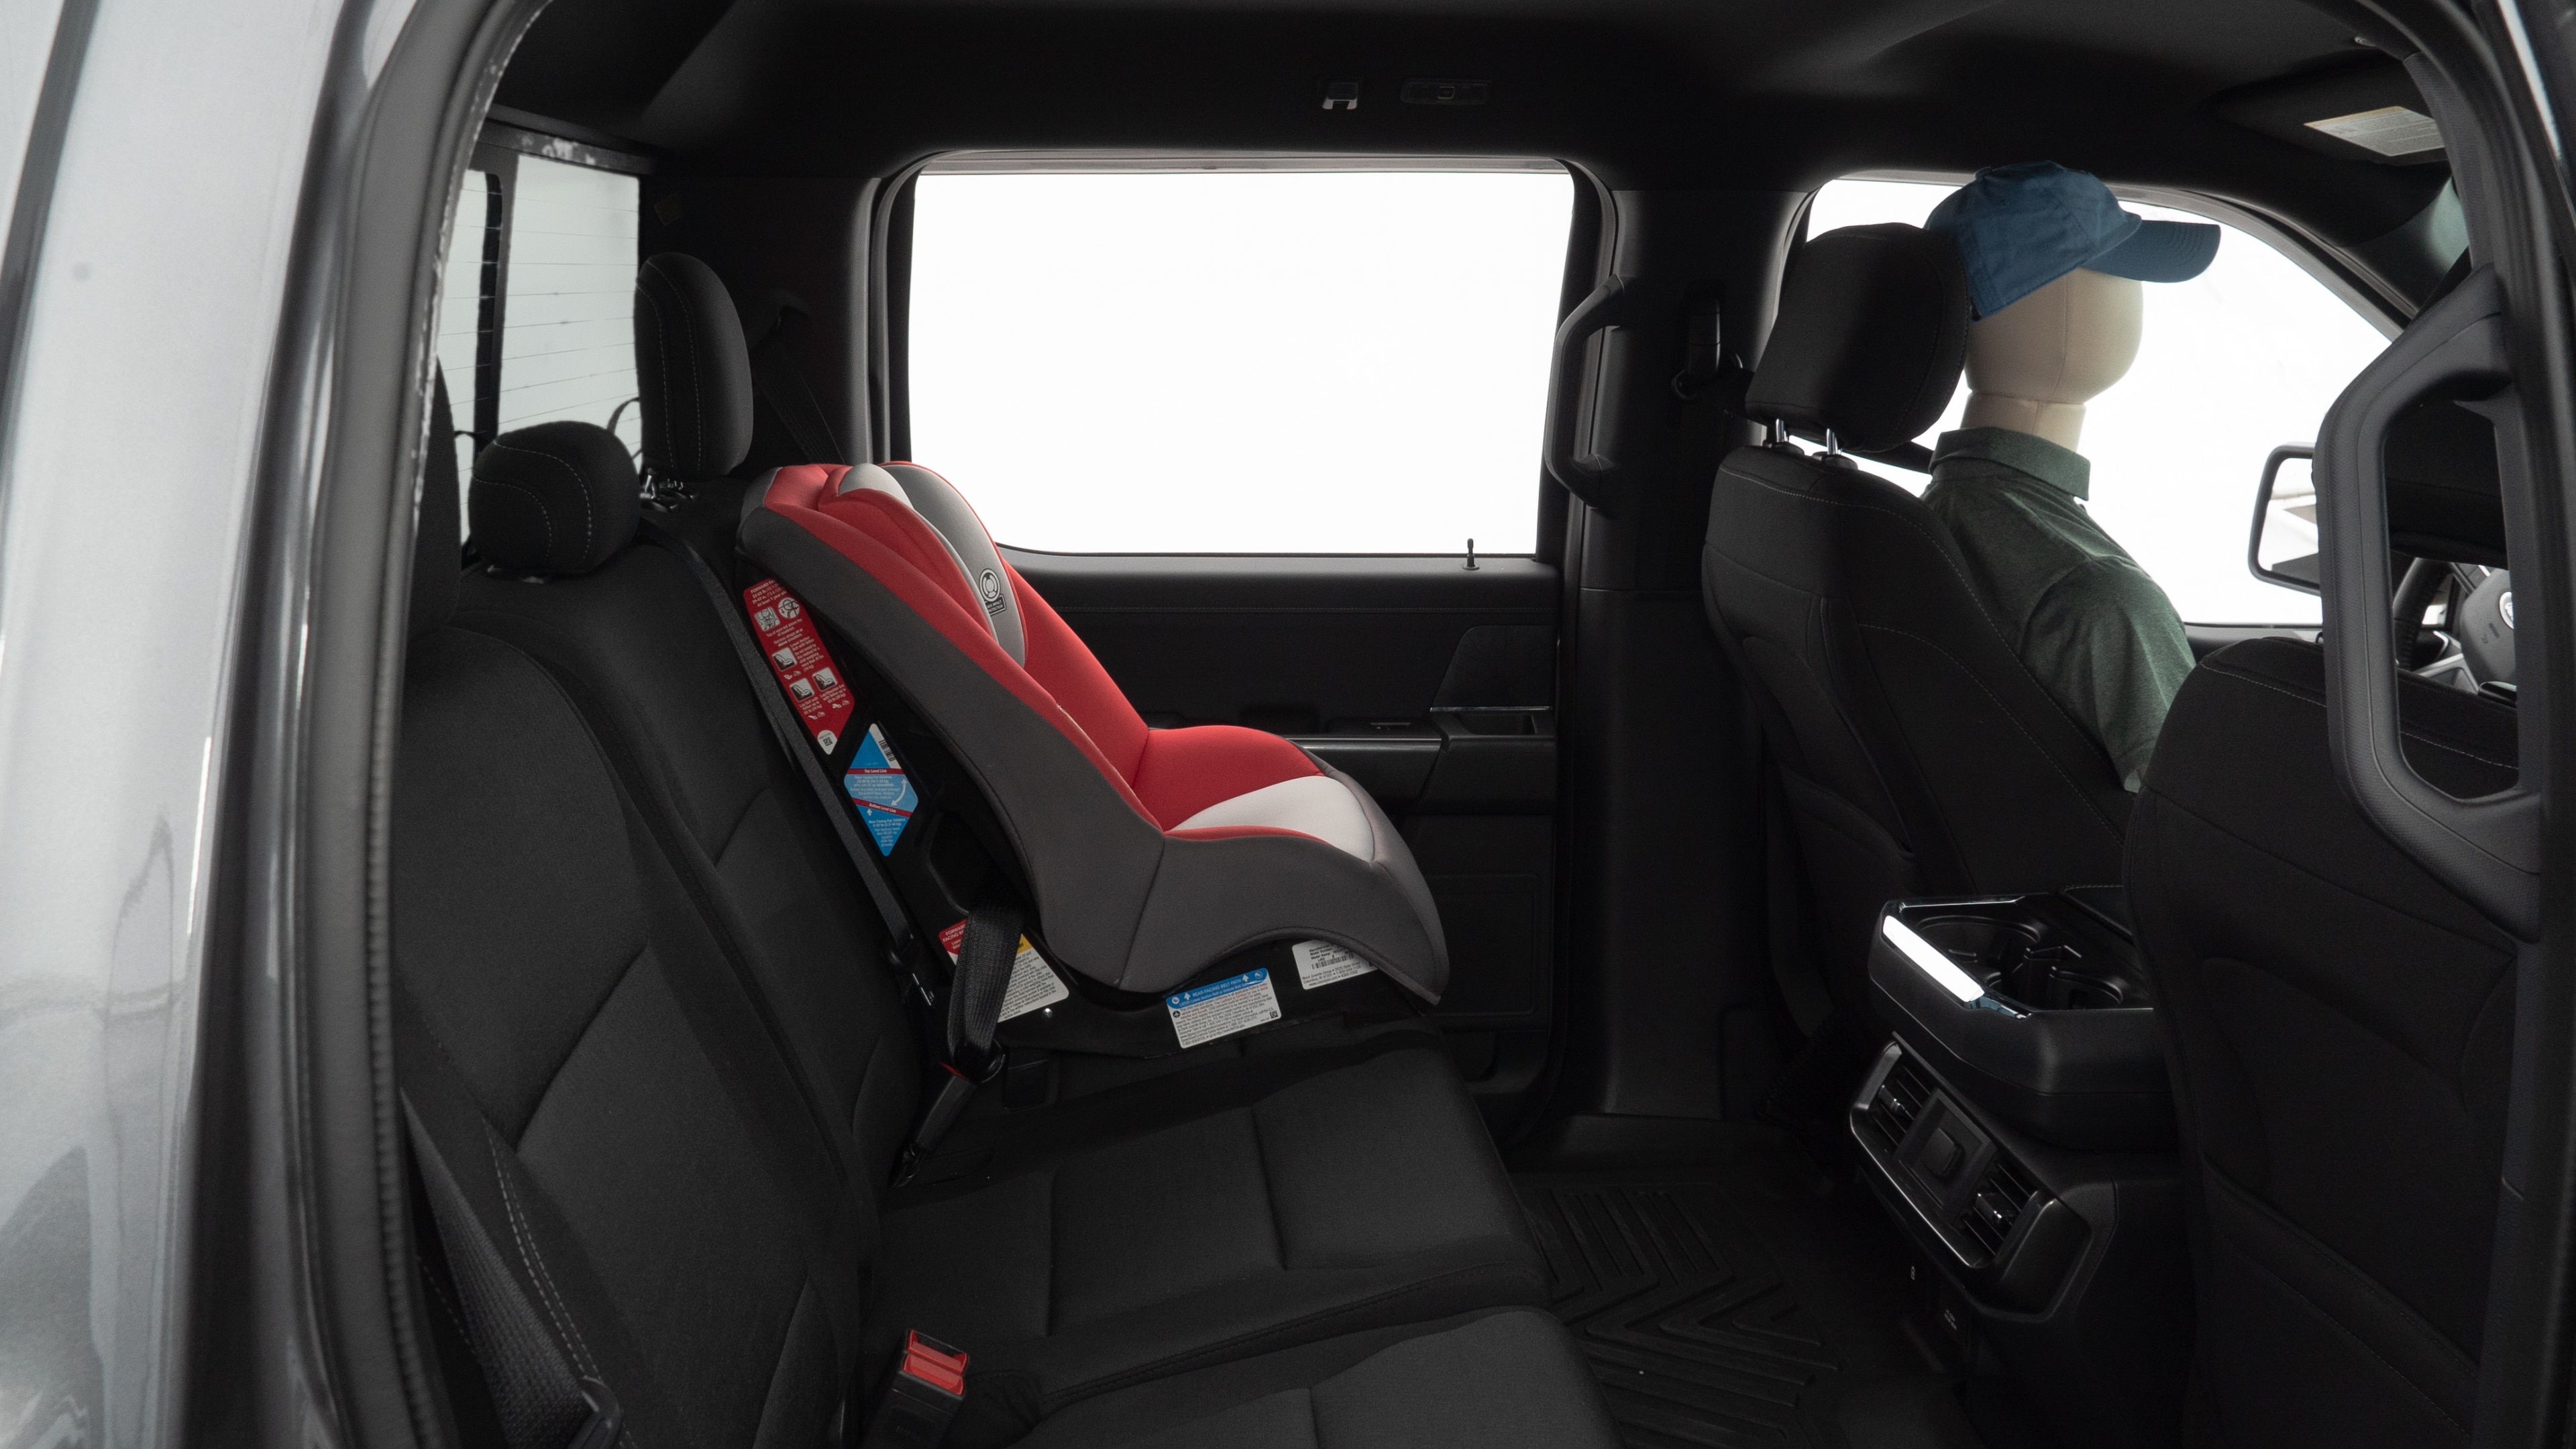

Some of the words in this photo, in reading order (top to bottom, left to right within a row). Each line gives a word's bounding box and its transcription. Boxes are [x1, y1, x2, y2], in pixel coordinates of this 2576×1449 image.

[750, 582, 769, 594] FORWARD
[943, 932, 959, 943] FACING
[1192, 985, 1221, 997] REAR-FACING
